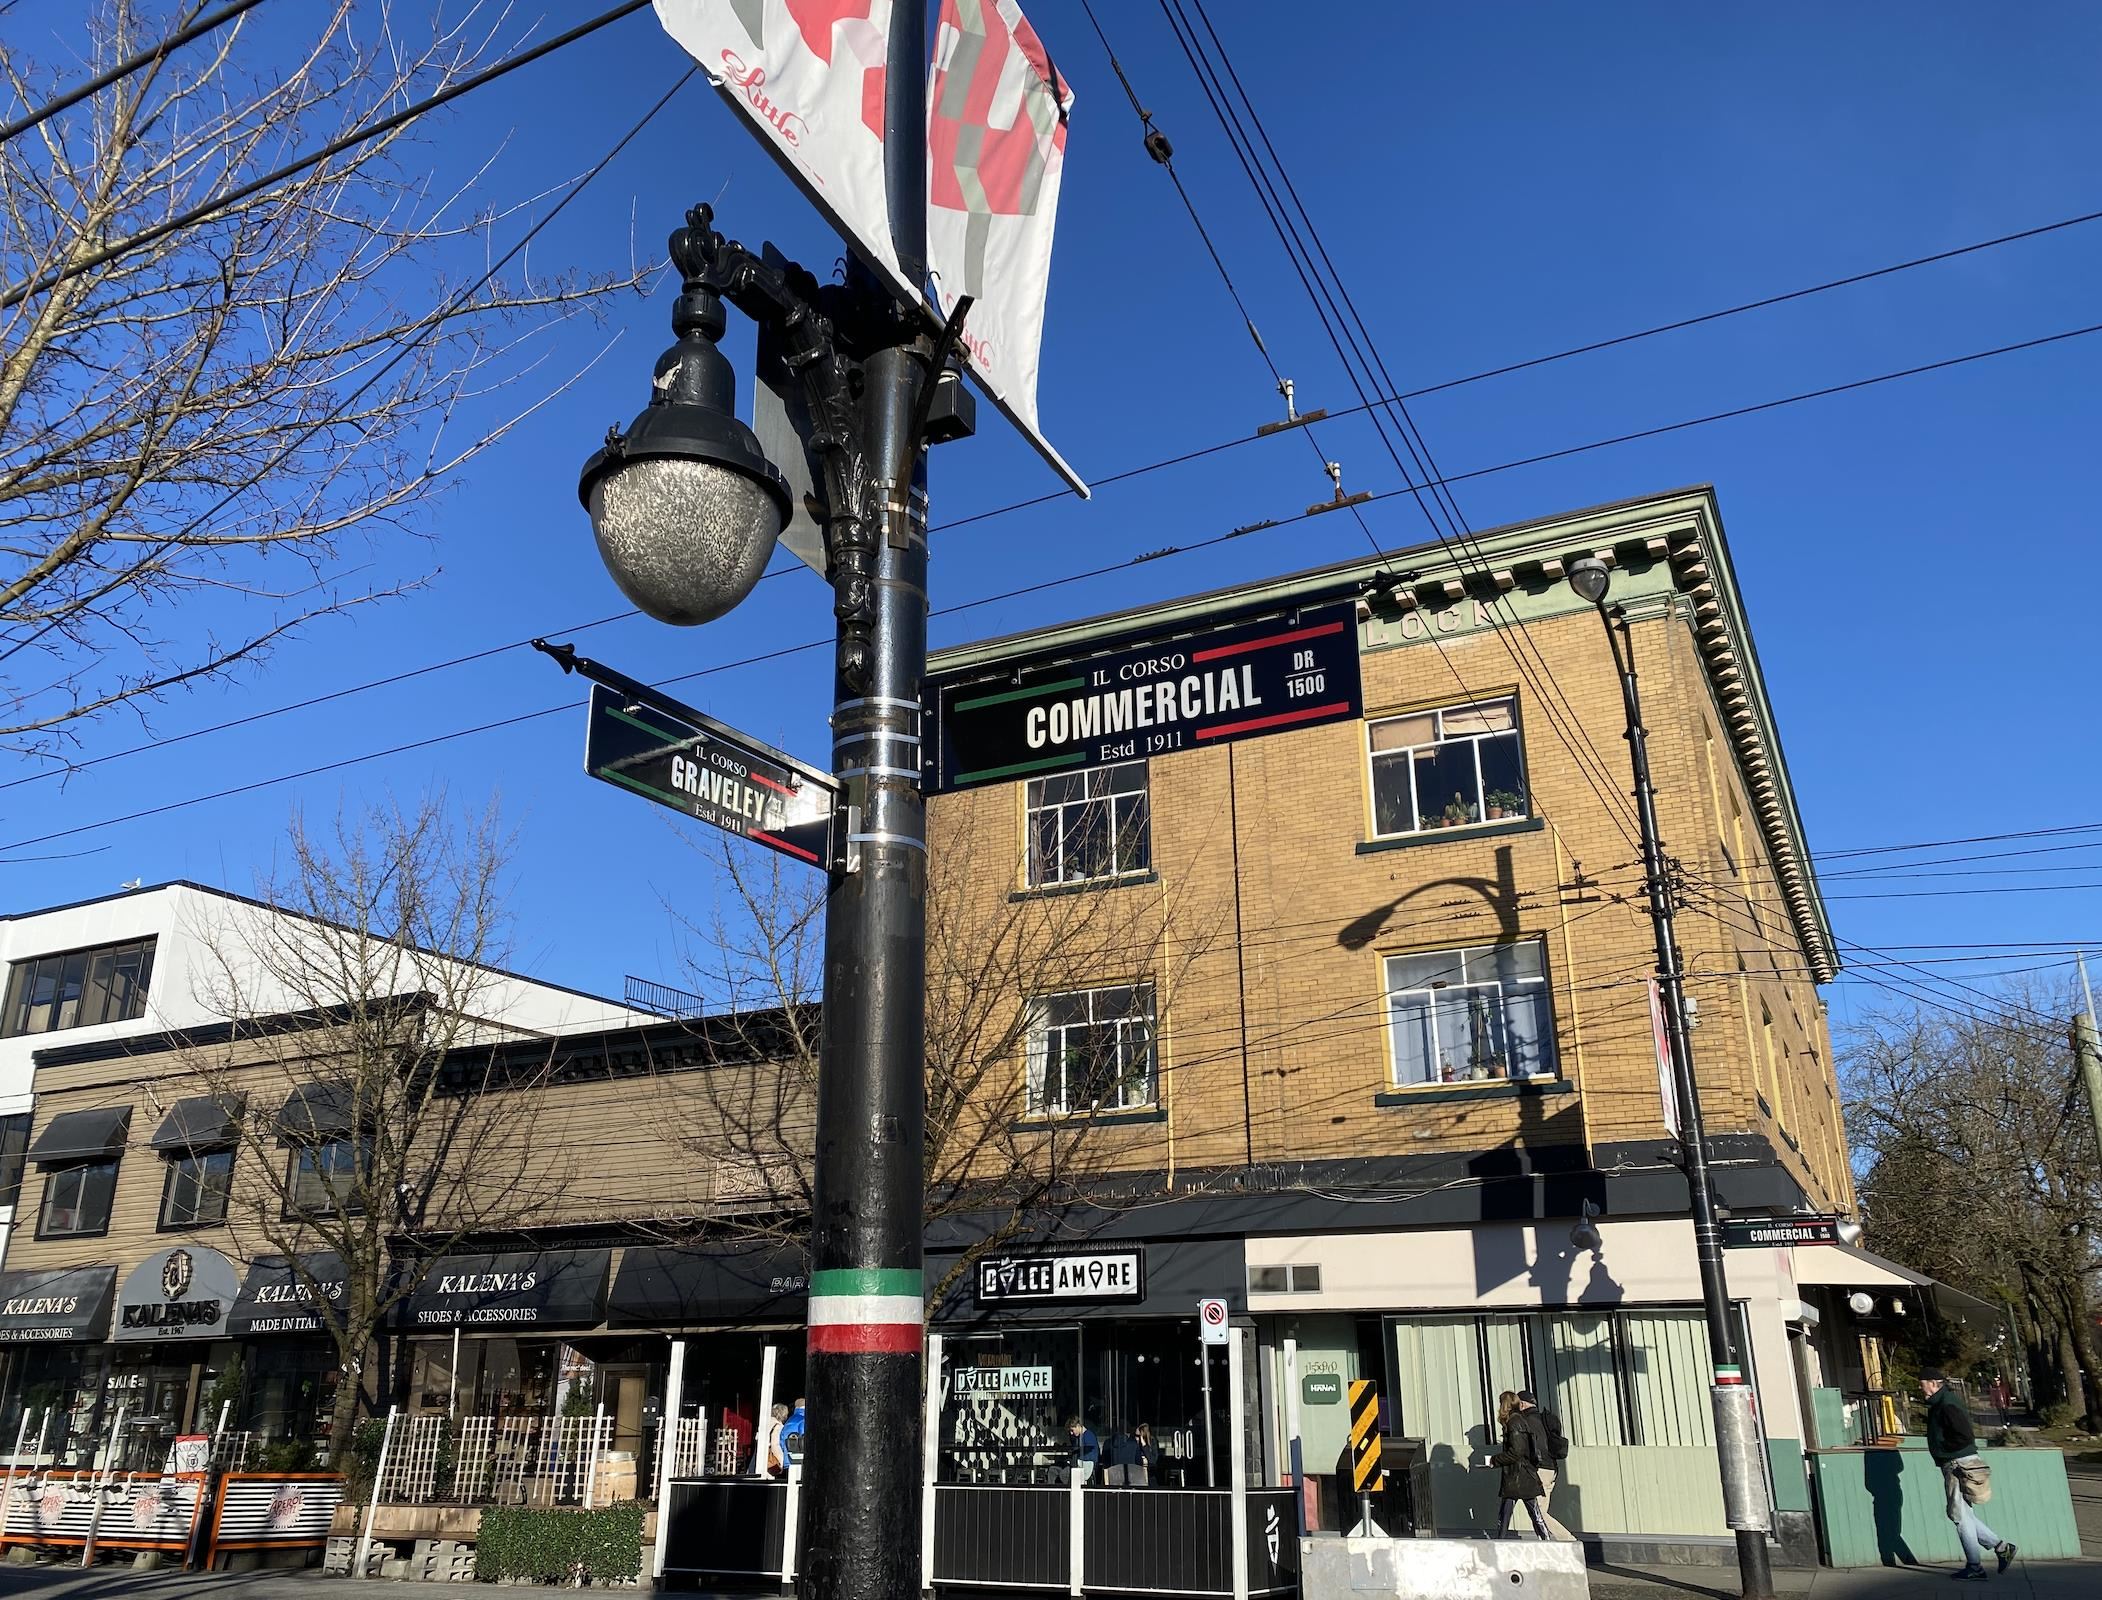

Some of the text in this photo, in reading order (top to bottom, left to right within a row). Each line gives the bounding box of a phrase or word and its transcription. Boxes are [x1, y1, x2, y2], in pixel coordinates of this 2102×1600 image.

[721, 48, 809, 147] Little
[1093, 653, 1185, 687] IL CORSO
[1294, 650, 1314, 670] DR
[1287, 674, 1325, 698] 1500
[1027, 664, 1262, 749] COMMERCIAL
[1100, 730, 1182, 761] Estd 1911
[696, 745, 747, 778] IL CORSO
[671, 755, 765, 822] GRAVELEY
[695, 803, 740, 833] Estd 1911
[1750, 1227, 1815, 1242] COMMERCIAL
[437, 1271, 537, 1294] KALENA'S
[769, 1276, 805, 1293] BAR
[1058, 1260, 1130, 1290] AMORE
[2, 1296, 78, 1315] KALENA'S
[418, 1308, 537, 1323] SHOES & ACCESSORIES
[11, 1330, 18, 1340] &
[19, 1327, 73, 1340] ACCESSORIES
[250, 1319, 280, 1332] MADE
[281, 1318, 295, 1331] IN
[1004, 1369, 1048, 1388] AMORE
[1025, 1392, 1053, 1400] TREATS
